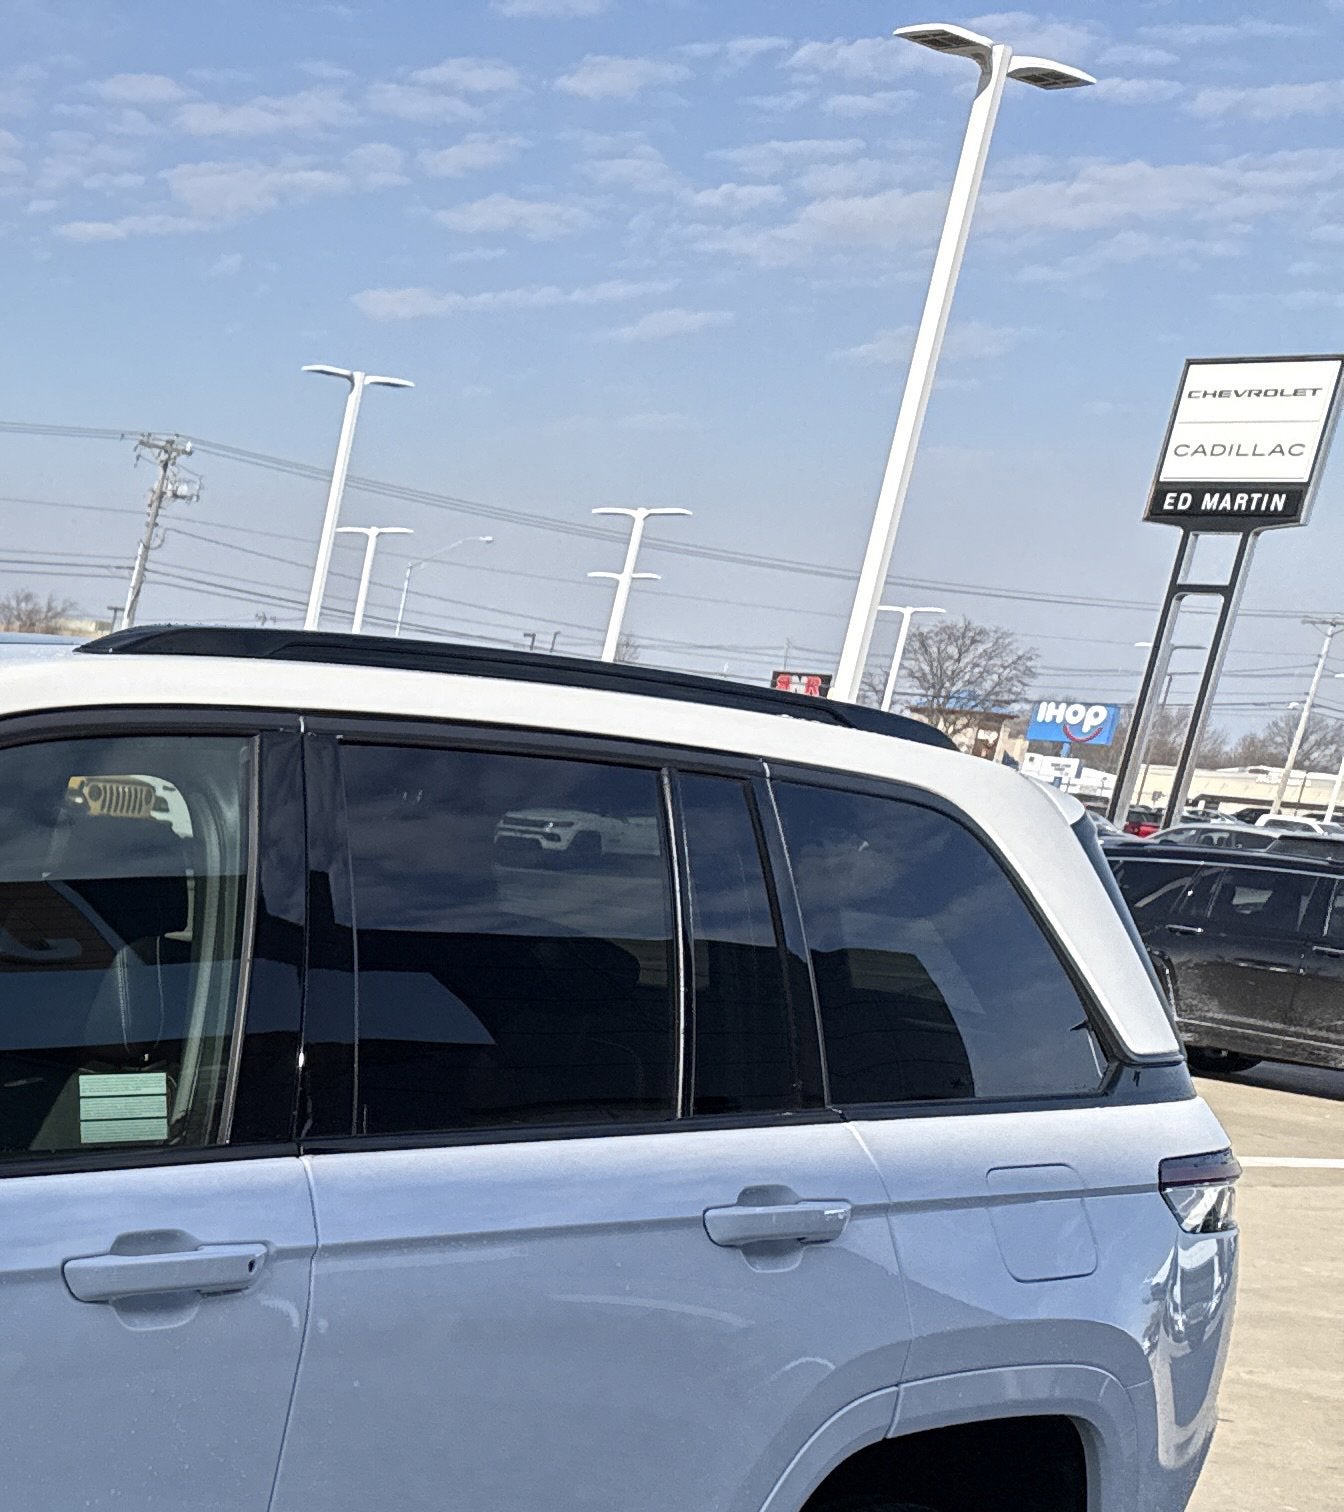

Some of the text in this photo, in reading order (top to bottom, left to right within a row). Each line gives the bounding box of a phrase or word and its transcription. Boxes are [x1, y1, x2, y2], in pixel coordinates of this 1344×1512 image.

[1187, 388, 1323, 399] CHEVROLET
[1173, 443, 1306, 457] CADILLAC
[1163, 493, 1287, 512] ED MARTIN
